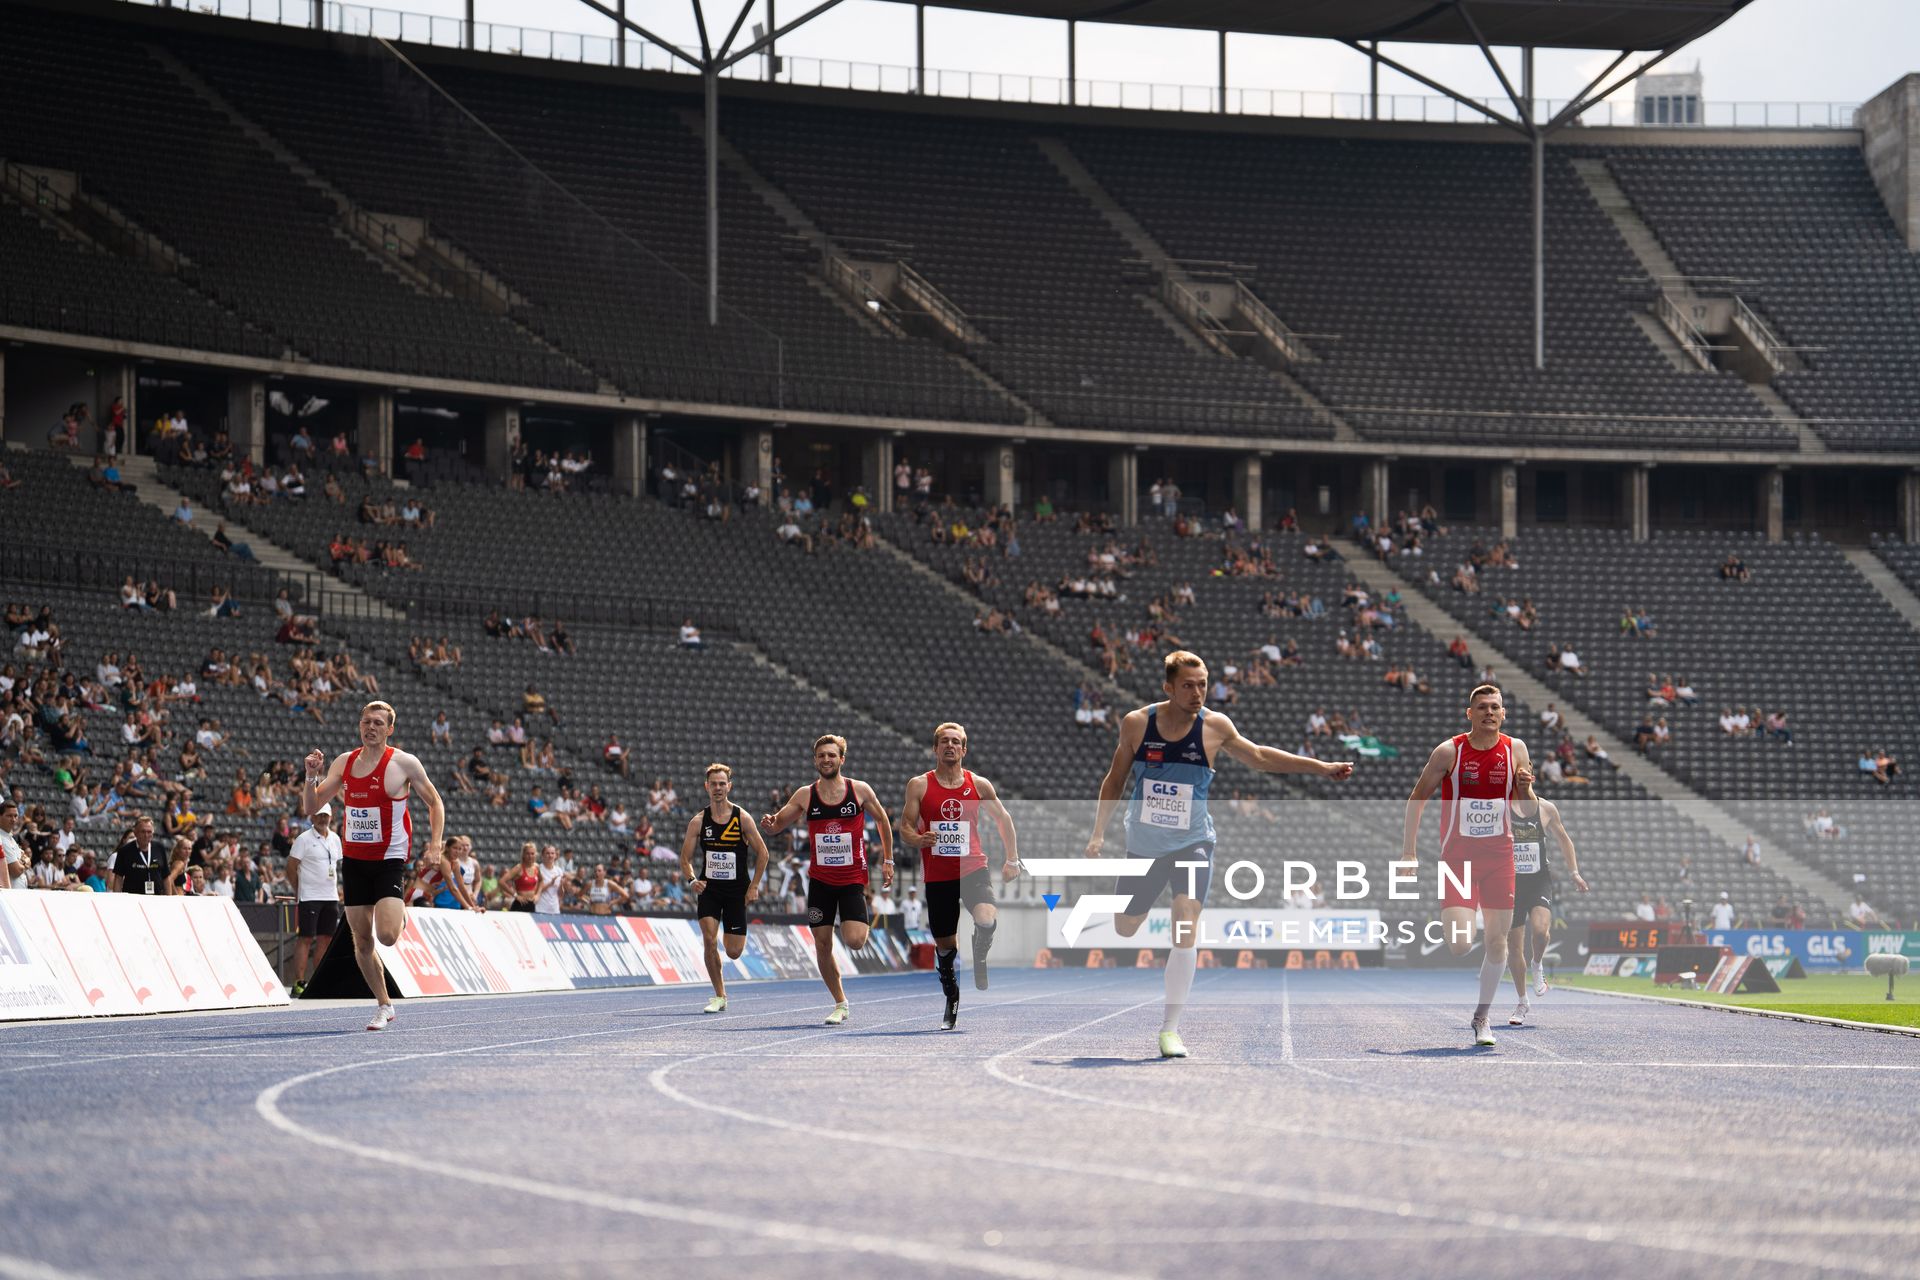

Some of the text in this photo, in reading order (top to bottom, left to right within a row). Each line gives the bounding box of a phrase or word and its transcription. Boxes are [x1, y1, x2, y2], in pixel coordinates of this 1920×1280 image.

[1692, 305, 1707, 319] 17
[1146, 795, 1187, 813] SCHLEGEL
[1470, 801, 1494, 810] GLS
[351, 809, 369, 818] GLS
[1466, 812, 1499, 824] KOCH
[353, 820, 379, 830] KRAUSE
[938, 822, 959, 831] GLS
[822, 835, 841, 844] GLS
[707, 861, 735, 870] LEPPELSACK
[1291, 953, 1299, 965] 3
